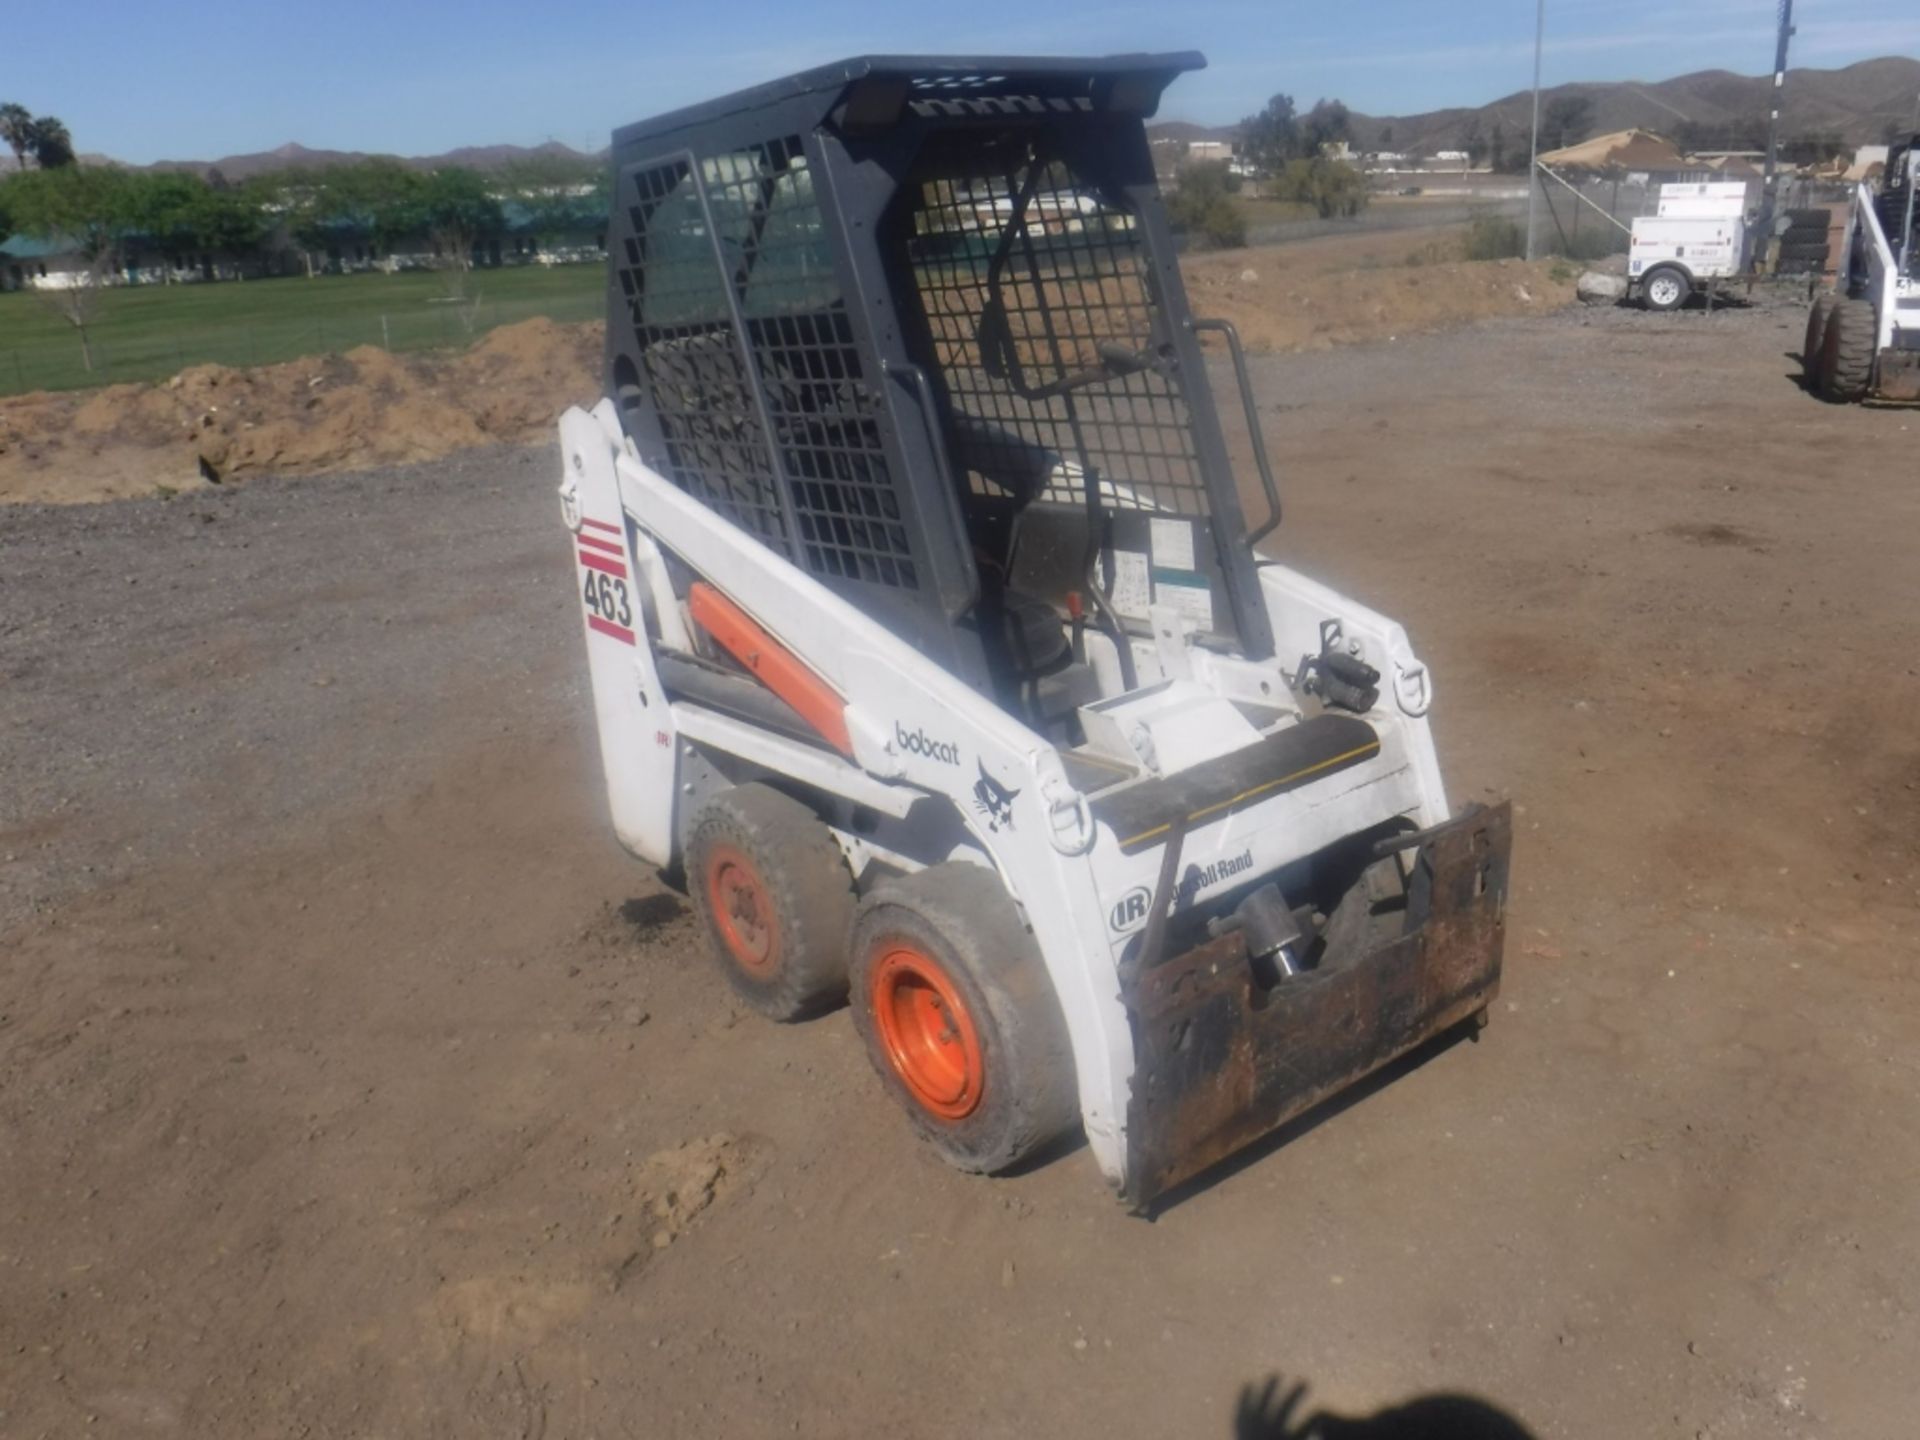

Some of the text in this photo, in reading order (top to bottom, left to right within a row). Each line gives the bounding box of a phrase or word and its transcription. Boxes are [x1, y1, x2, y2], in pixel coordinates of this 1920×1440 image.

[583, 569, 632, 628] 463
[895, 719, 961, 766] bobcat
[1116, 892, 1146, 927] IR
